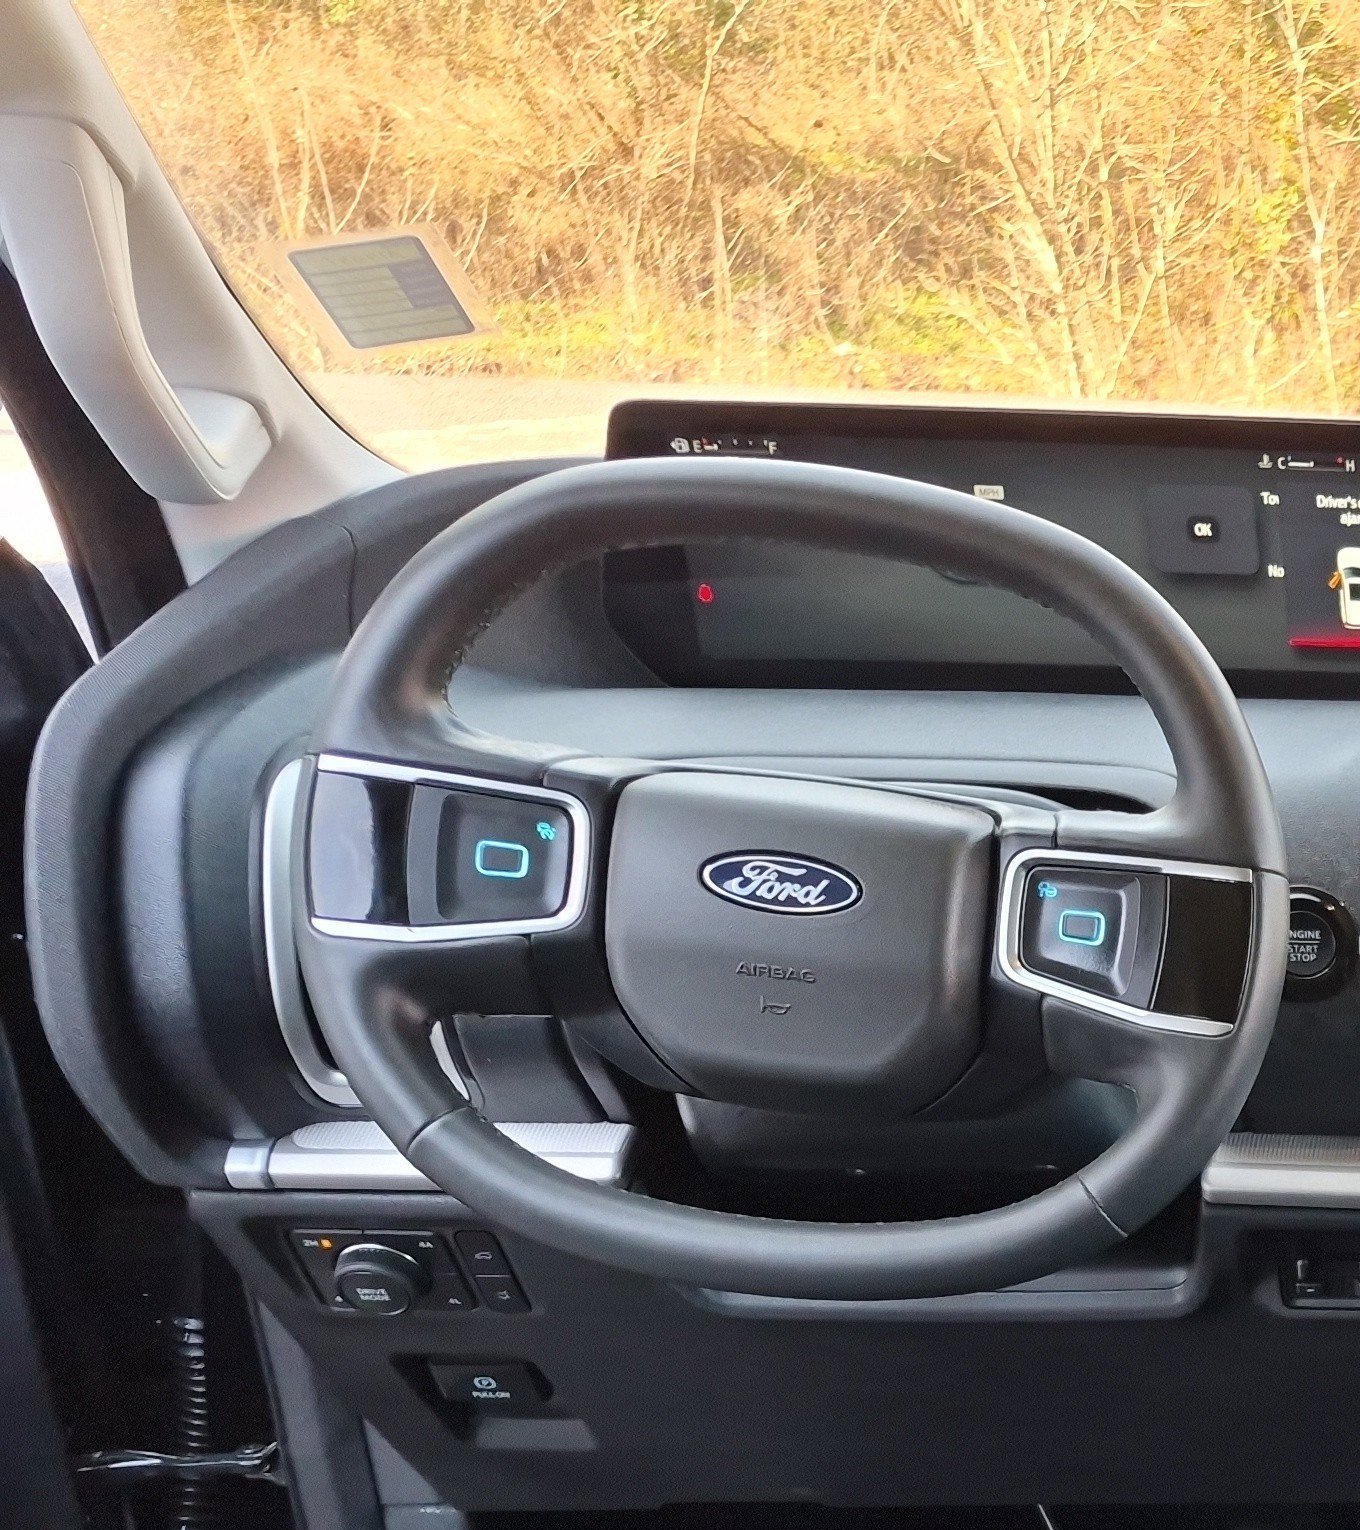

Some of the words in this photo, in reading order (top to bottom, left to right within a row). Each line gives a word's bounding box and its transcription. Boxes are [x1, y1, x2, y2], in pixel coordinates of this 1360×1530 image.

[1345, 458, 1356, 473] H
[1193, 522, 1213, 537] OK
[722, 860, 831, 906] Ford
[1289, 930, 1322, 940] NGINE
[1289, 953, 1317, 962] STOP
[735, 960, 818, 985] AIRBAG
